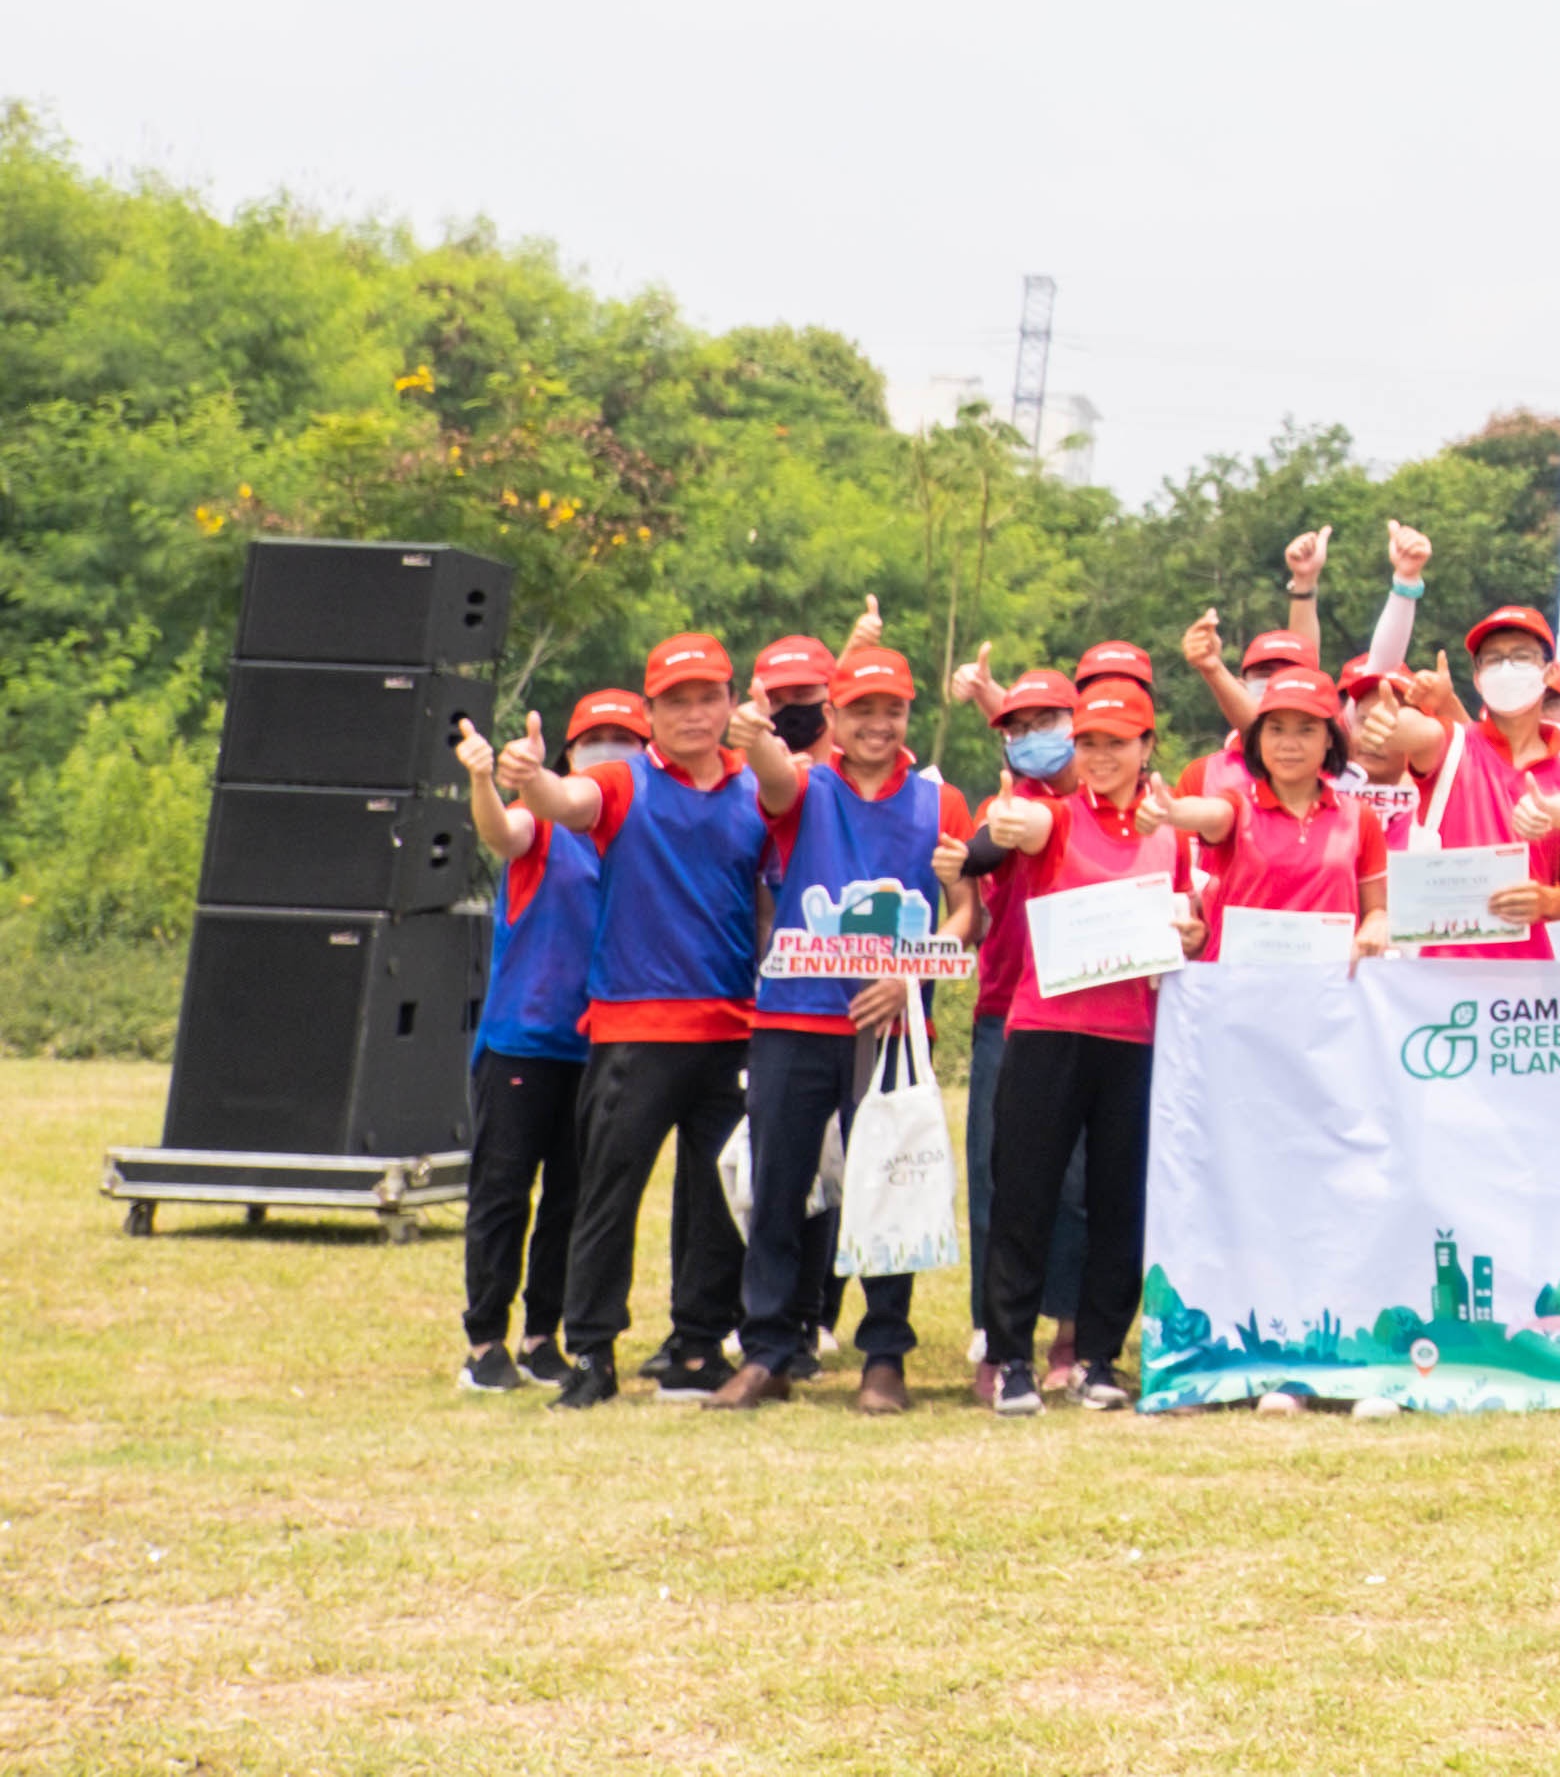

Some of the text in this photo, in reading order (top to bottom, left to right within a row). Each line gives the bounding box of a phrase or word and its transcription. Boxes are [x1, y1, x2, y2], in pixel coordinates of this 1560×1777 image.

[779, 935, 959, 955] PLASTICS harm
[789, 956, 972, 975] ENVIRONMENT
